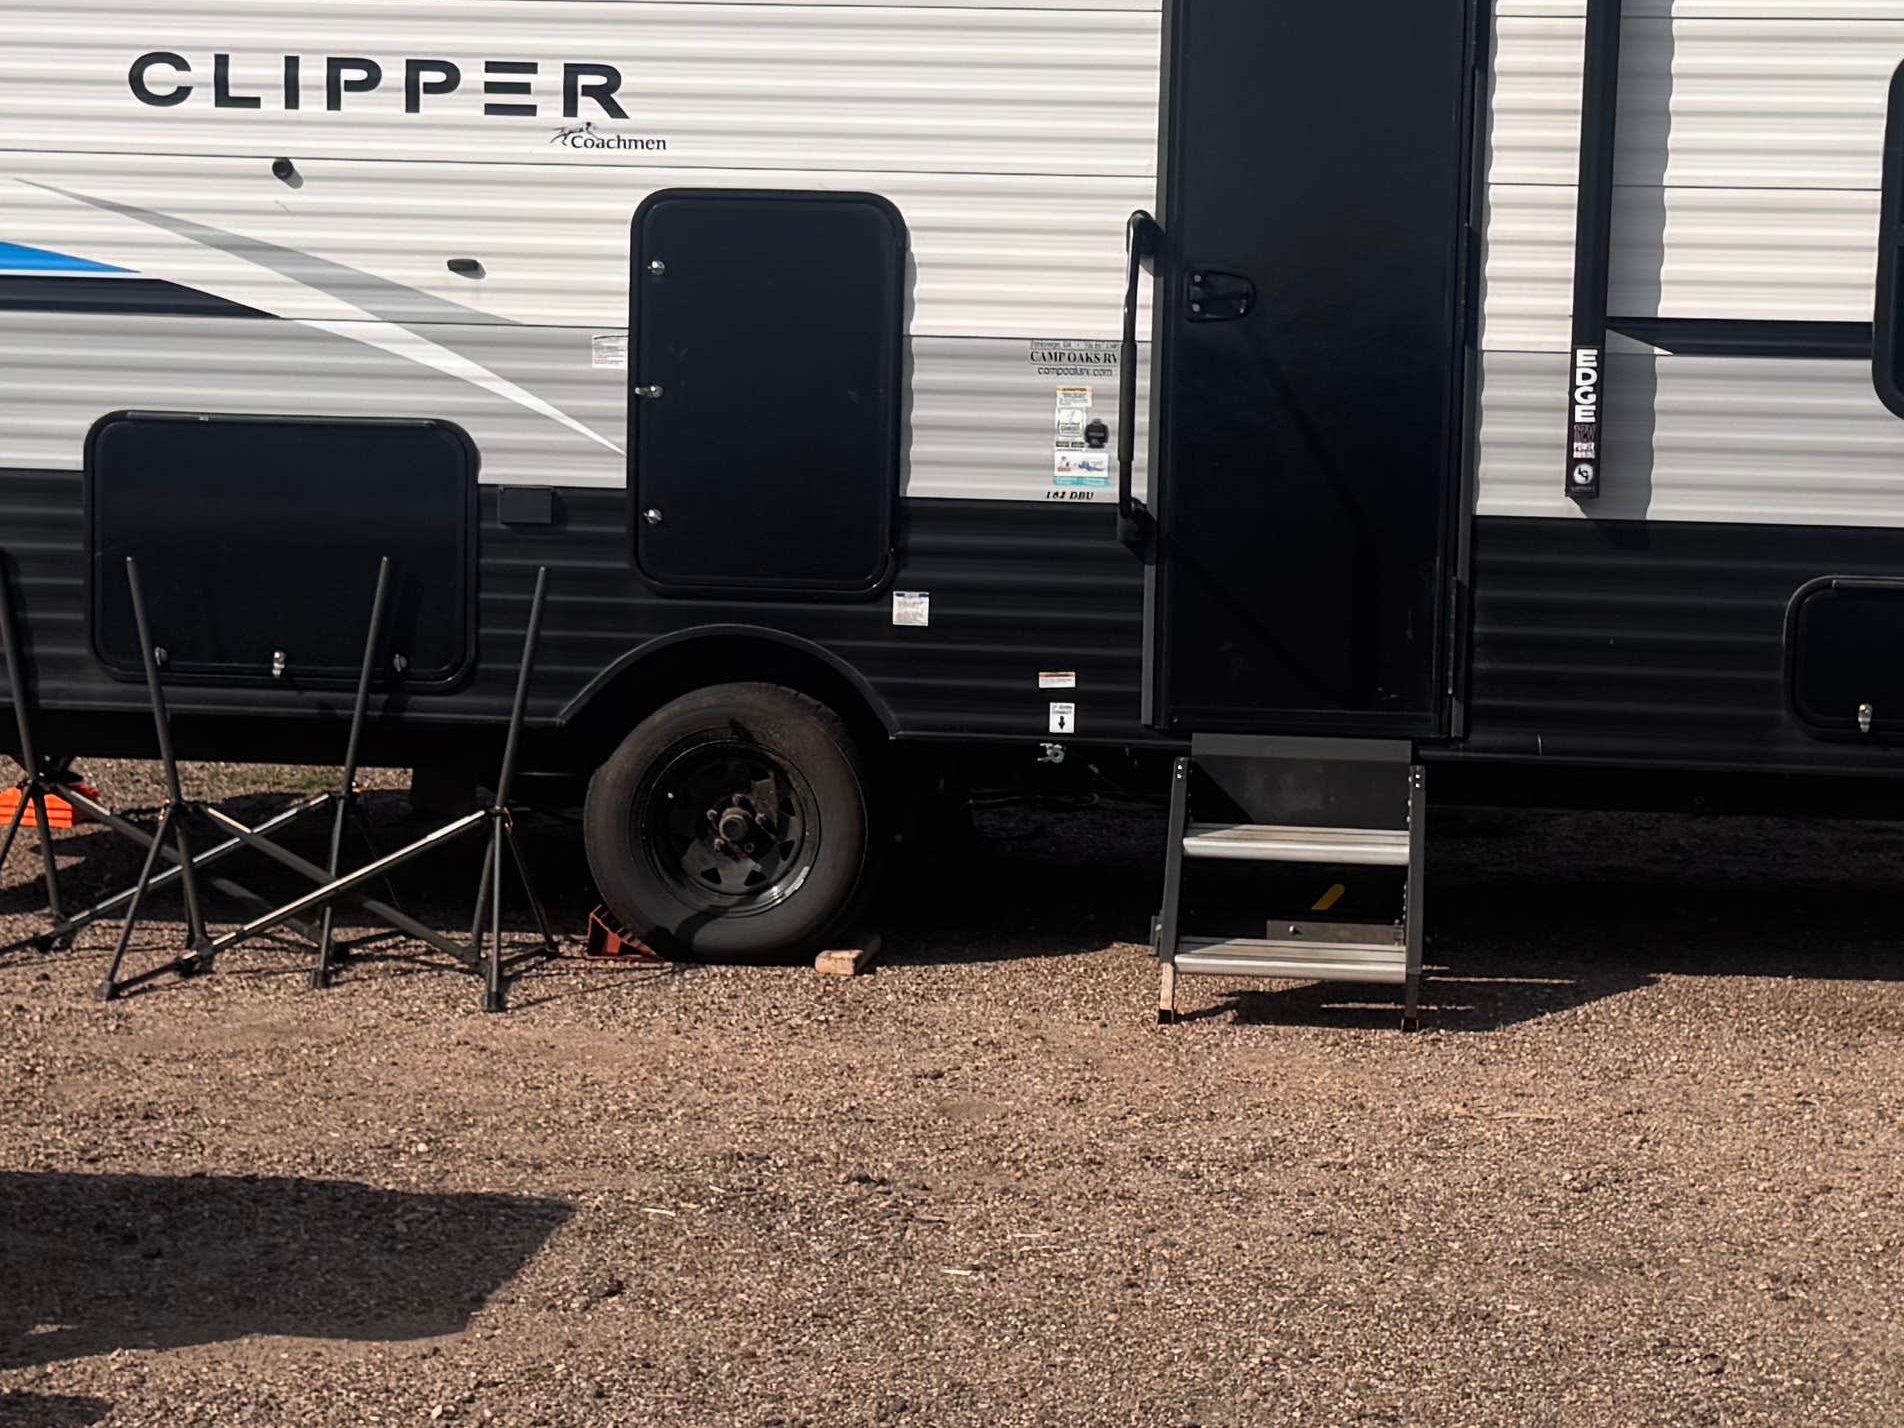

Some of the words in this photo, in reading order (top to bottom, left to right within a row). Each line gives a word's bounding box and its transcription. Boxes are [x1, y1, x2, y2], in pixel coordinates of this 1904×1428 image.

[127, 50, 630, 120] CLIPPER
[570, 133, 667, 150] Coachmen
[1067, 352, 1100, 364] OAKS
[1574, 348, 1598, 423] EDGE
